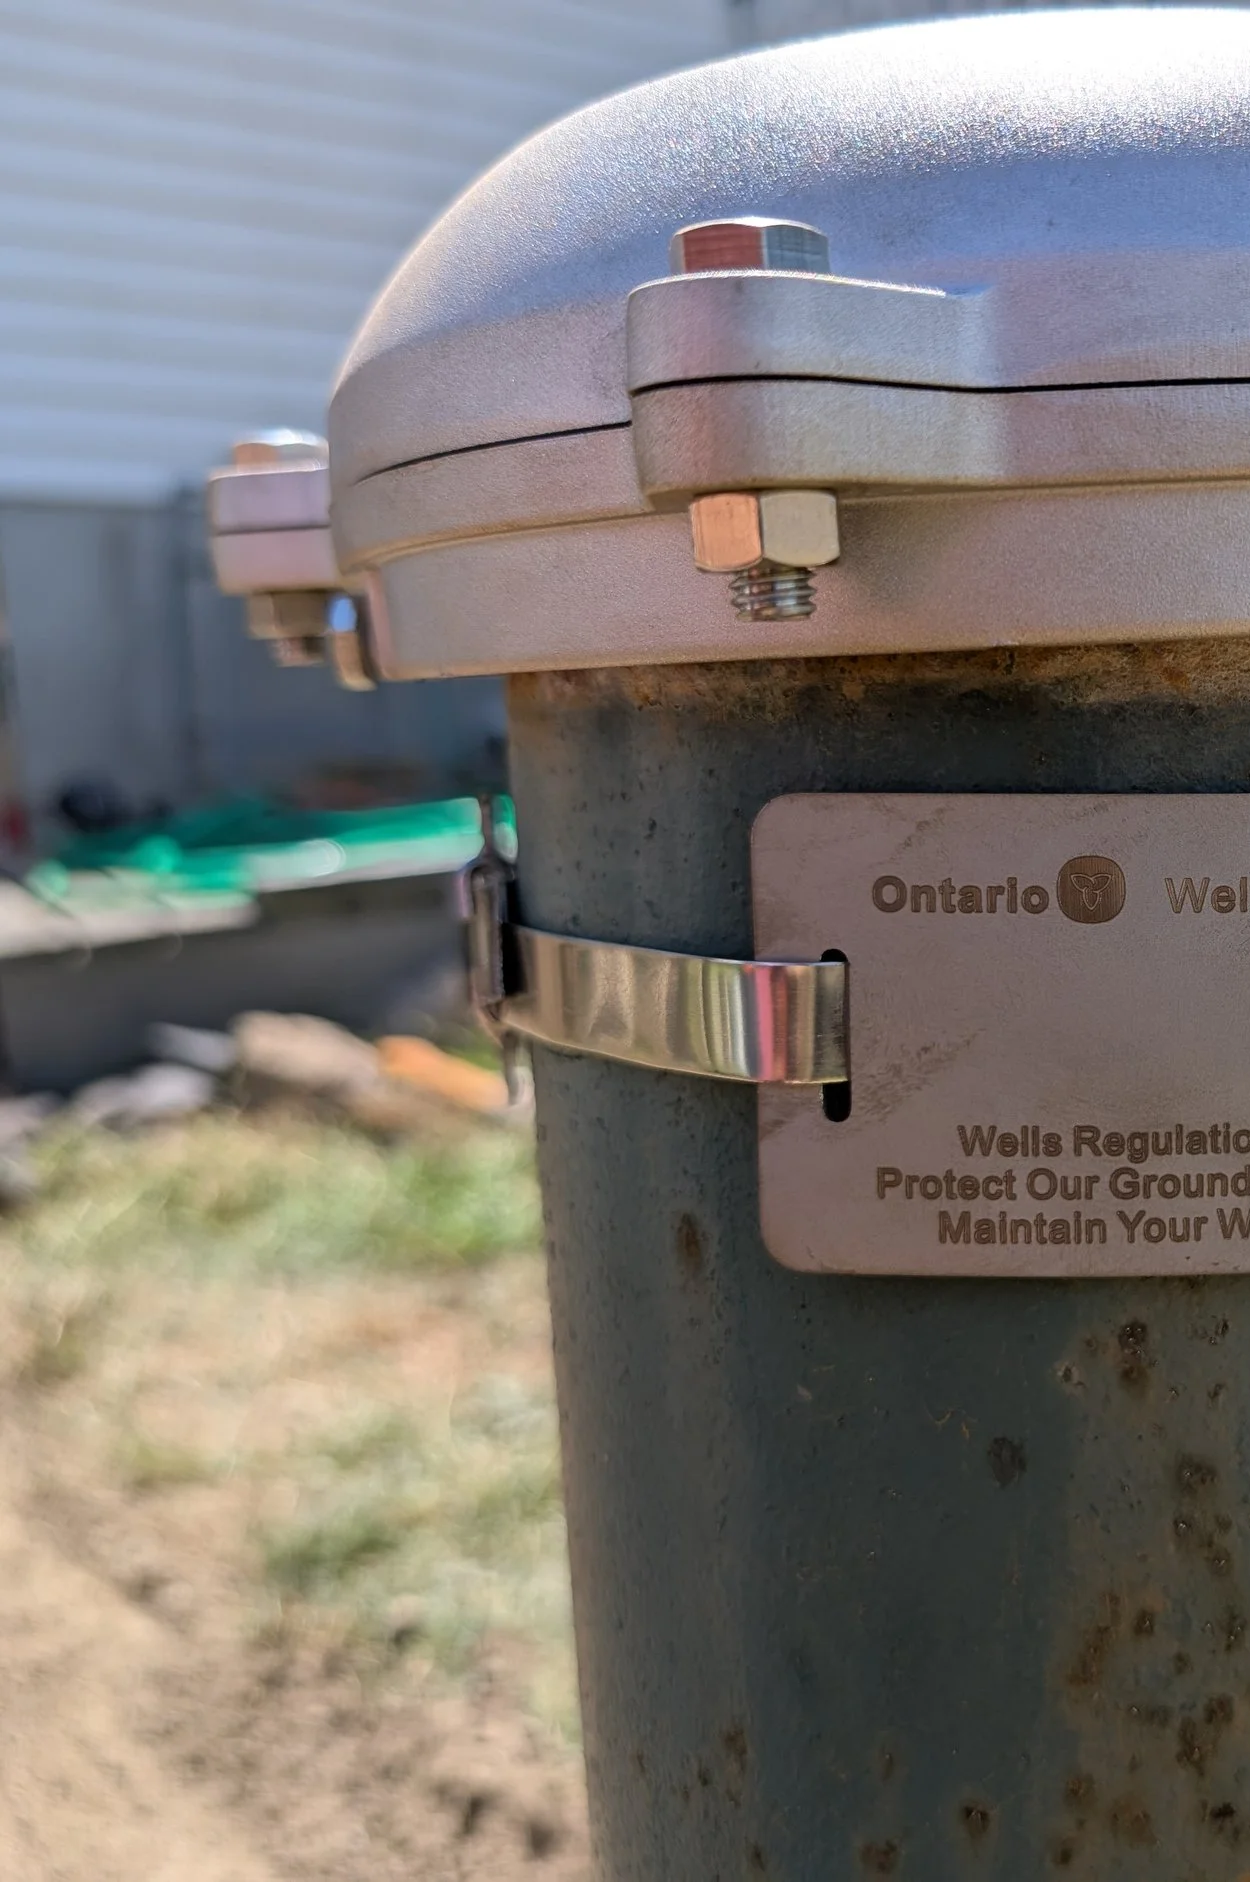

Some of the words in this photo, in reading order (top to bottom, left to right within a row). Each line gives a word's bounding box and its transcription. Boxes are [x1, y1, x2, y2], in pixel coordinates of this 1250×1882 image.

[872, 875, 1049, 914] Ontario
[957, 1125, 1063, 1157] Wells
[876, 1167, 1017, 1200] Protect
[1026, 1167, 1100, 1200] Our
[938, 1210, 1107, 1245] Maintain
[1116, 1210, 1208, 1243] Your
